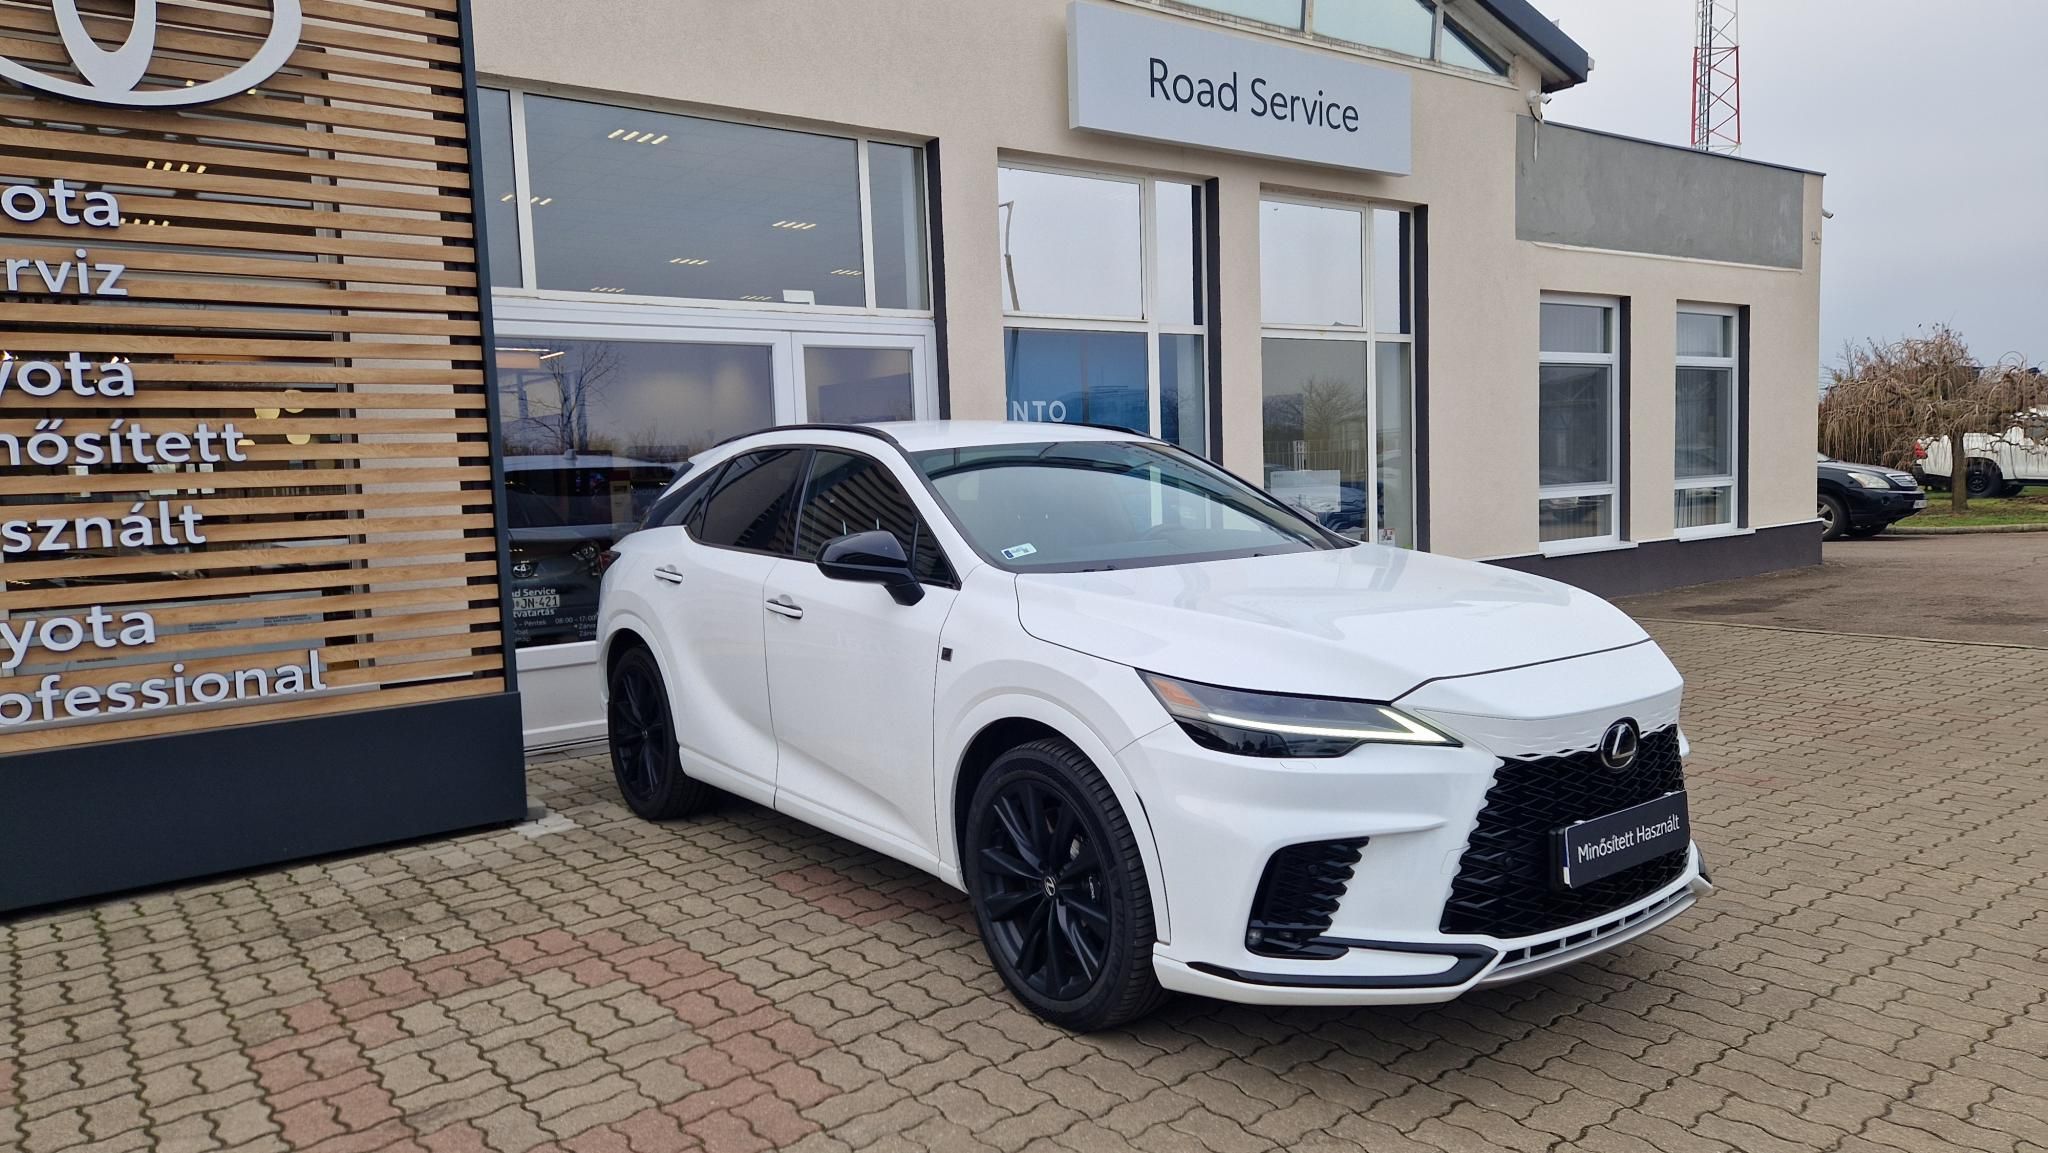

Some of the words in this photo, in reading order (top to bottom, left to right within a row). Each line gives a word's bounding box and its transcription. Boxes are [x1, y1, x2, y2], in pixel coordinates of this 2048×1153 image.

[1149, 57, 1238, 113] Road
[1250, 77, 1359, 133] Service
[1012, 400, 1067, 422] NTO
[522, 587, 556, 597] Service
[1577, 830, 1635, 864] Minősített
[1636, 813, 1680, 844] Használt
